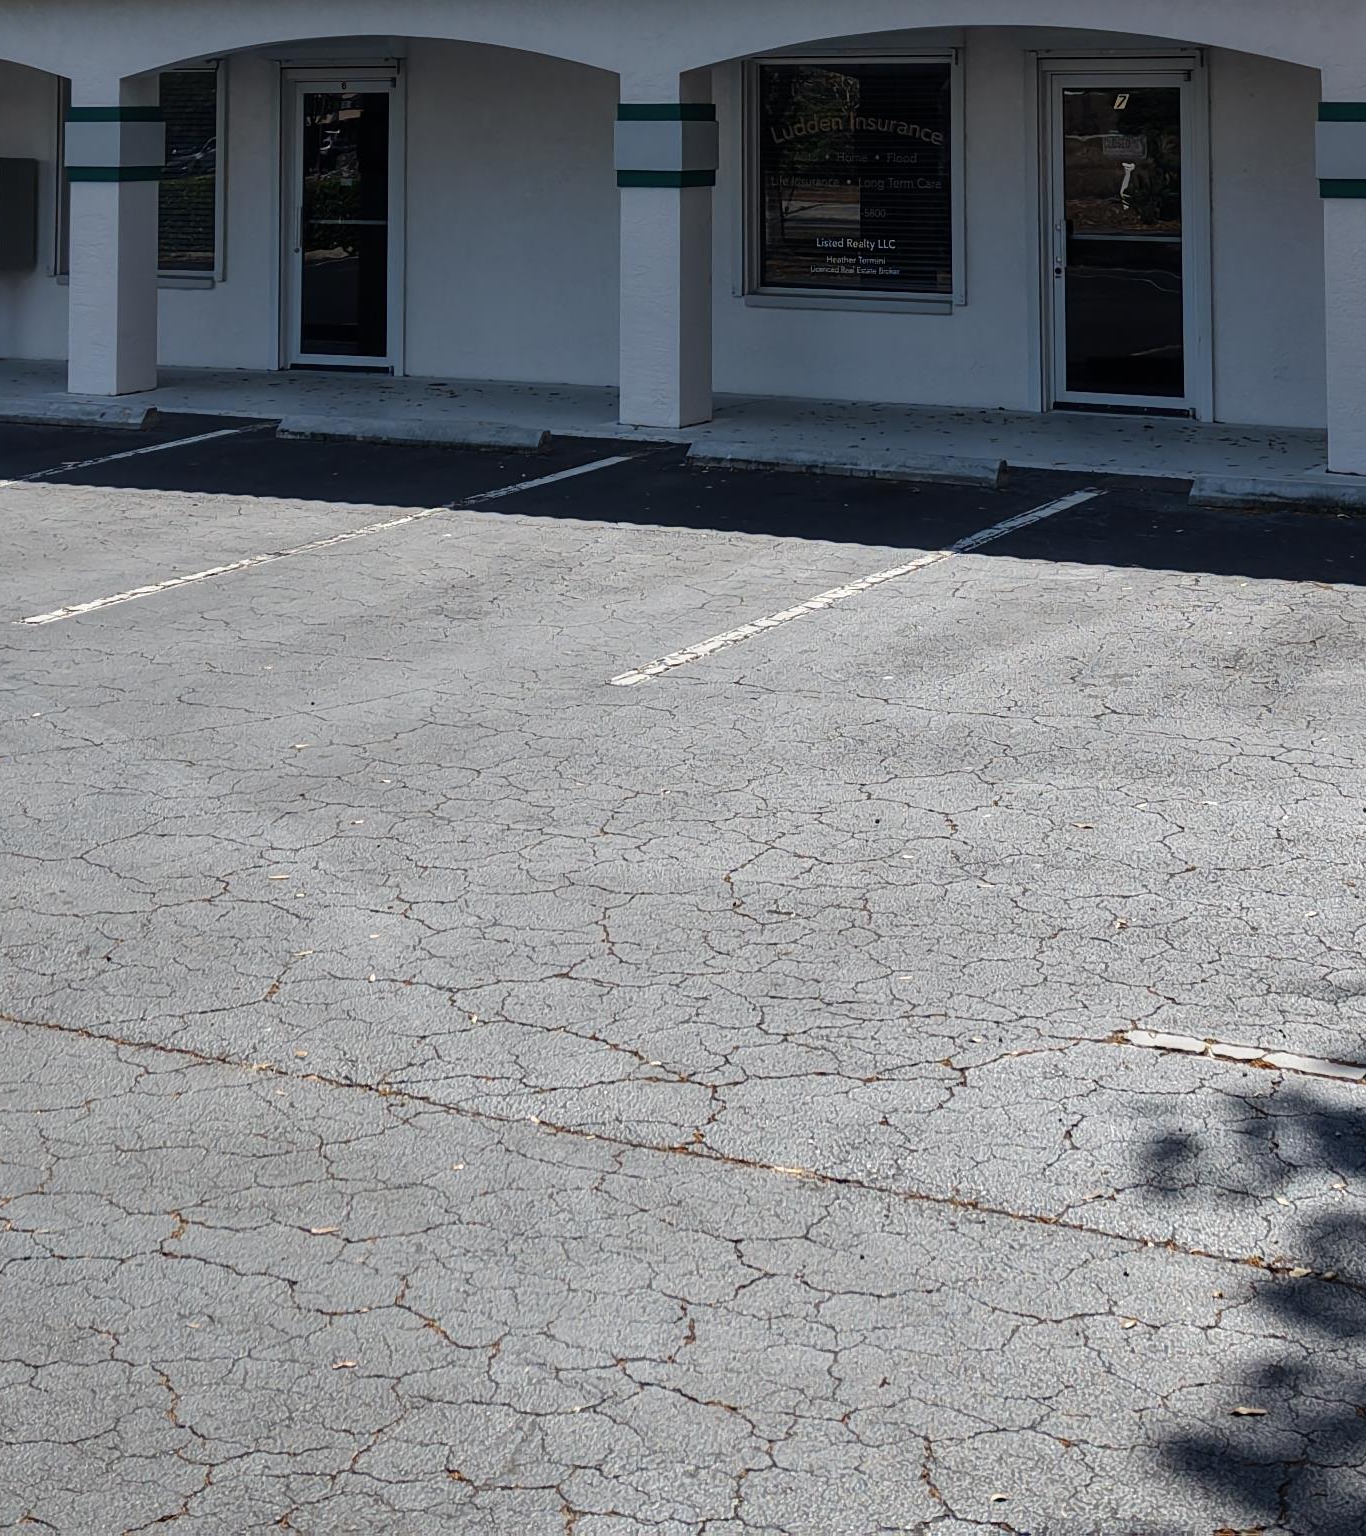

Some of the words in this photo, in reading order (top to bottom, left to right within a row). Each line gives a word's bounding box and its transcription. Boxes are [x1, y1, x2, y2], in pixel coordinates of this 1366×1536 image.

[1116, 95, 1127, 108] 7
[770, 113, 844, 145] Ludden
[849, 111, 945, 146] Insurance
[837, 152, 868, 163] Home
[885, 151, 918, 164] Flood
[793, 176, 841, 188] Insurance
[860, 176, 885, 191] Long
[887, 177, 914, 189] Term
[916, 177, 942, 190] Care
[816, 237, 844, 249] Listed
[846, 238, 876, 252] Realty
[877, 239, 897, 250] LLC
[826, 255, 857, 265] Heather
